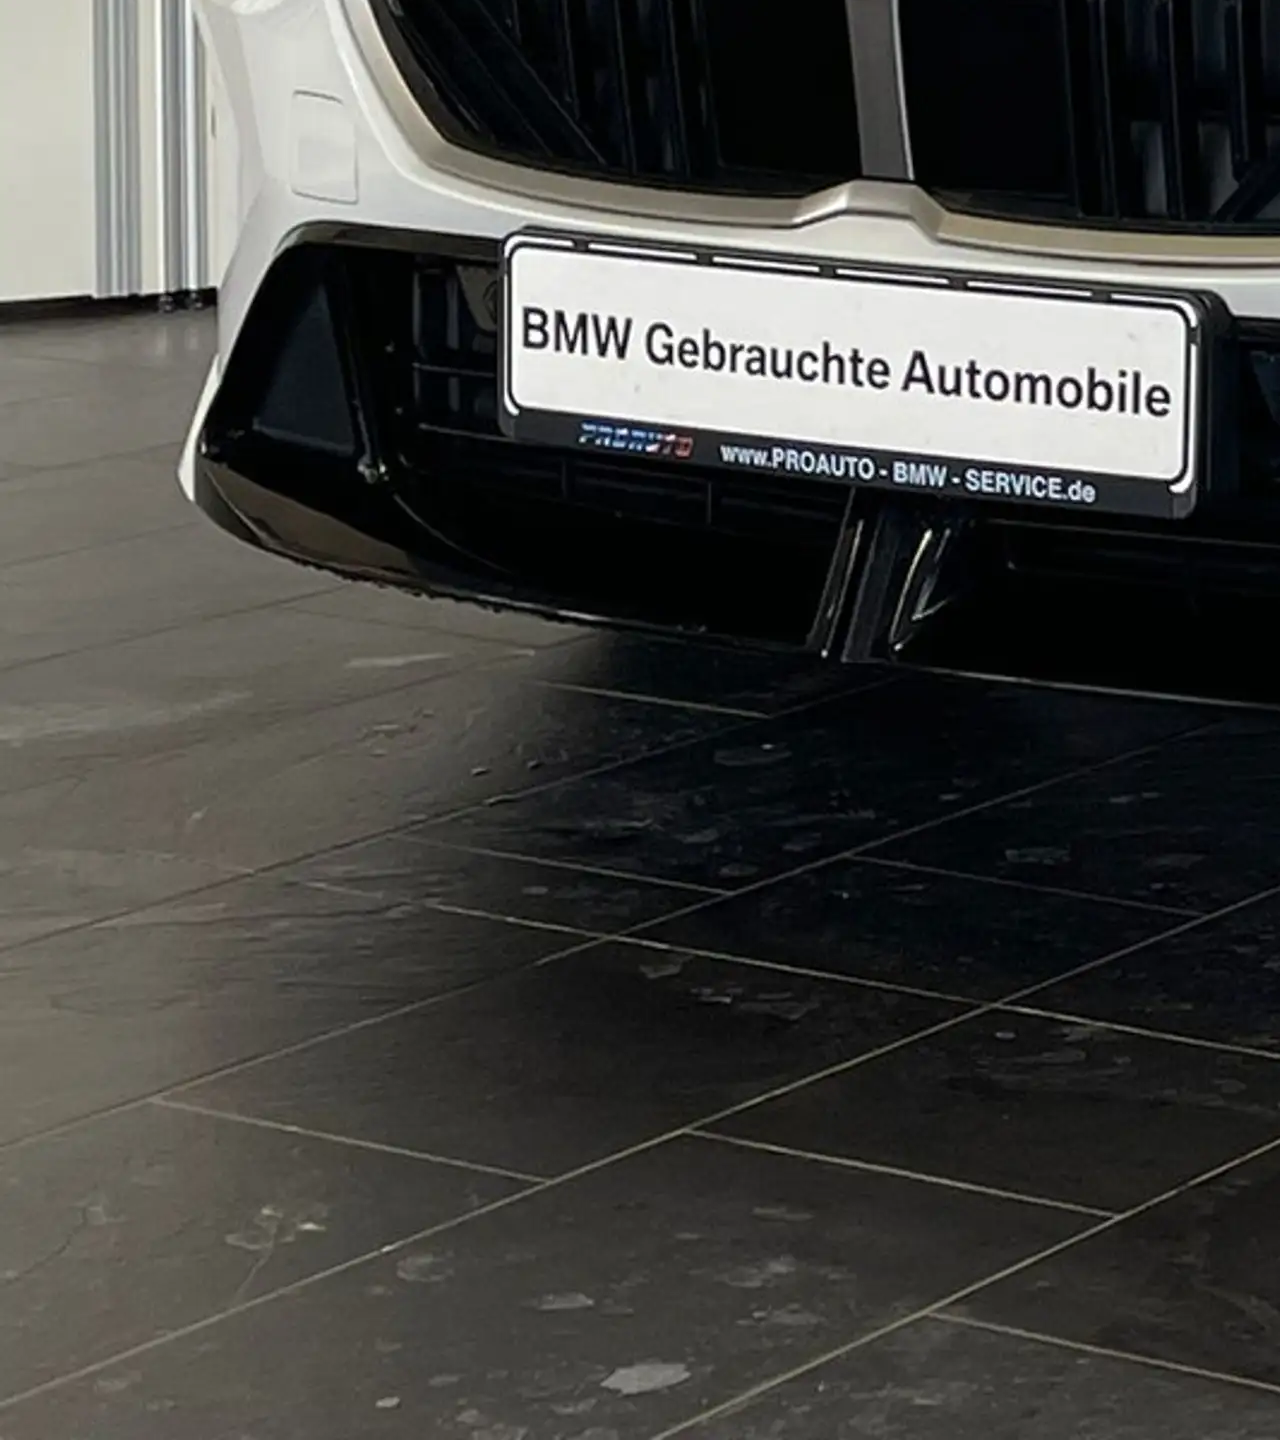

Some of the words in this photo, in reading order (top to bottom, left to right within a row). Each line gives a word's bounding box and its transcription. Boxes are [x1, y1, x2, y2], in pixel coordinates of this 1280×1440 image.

[522, 306, 632, 360] BMW
[645, 322, 890, 390] Gebrauchte
[901, 349, 1172, 418] Automobile
[719, 444, 875, 480] www.PROAUTO
[892, 461, 947, 487] BMW
[964, 468, 1096, 503] SERVICE.de
